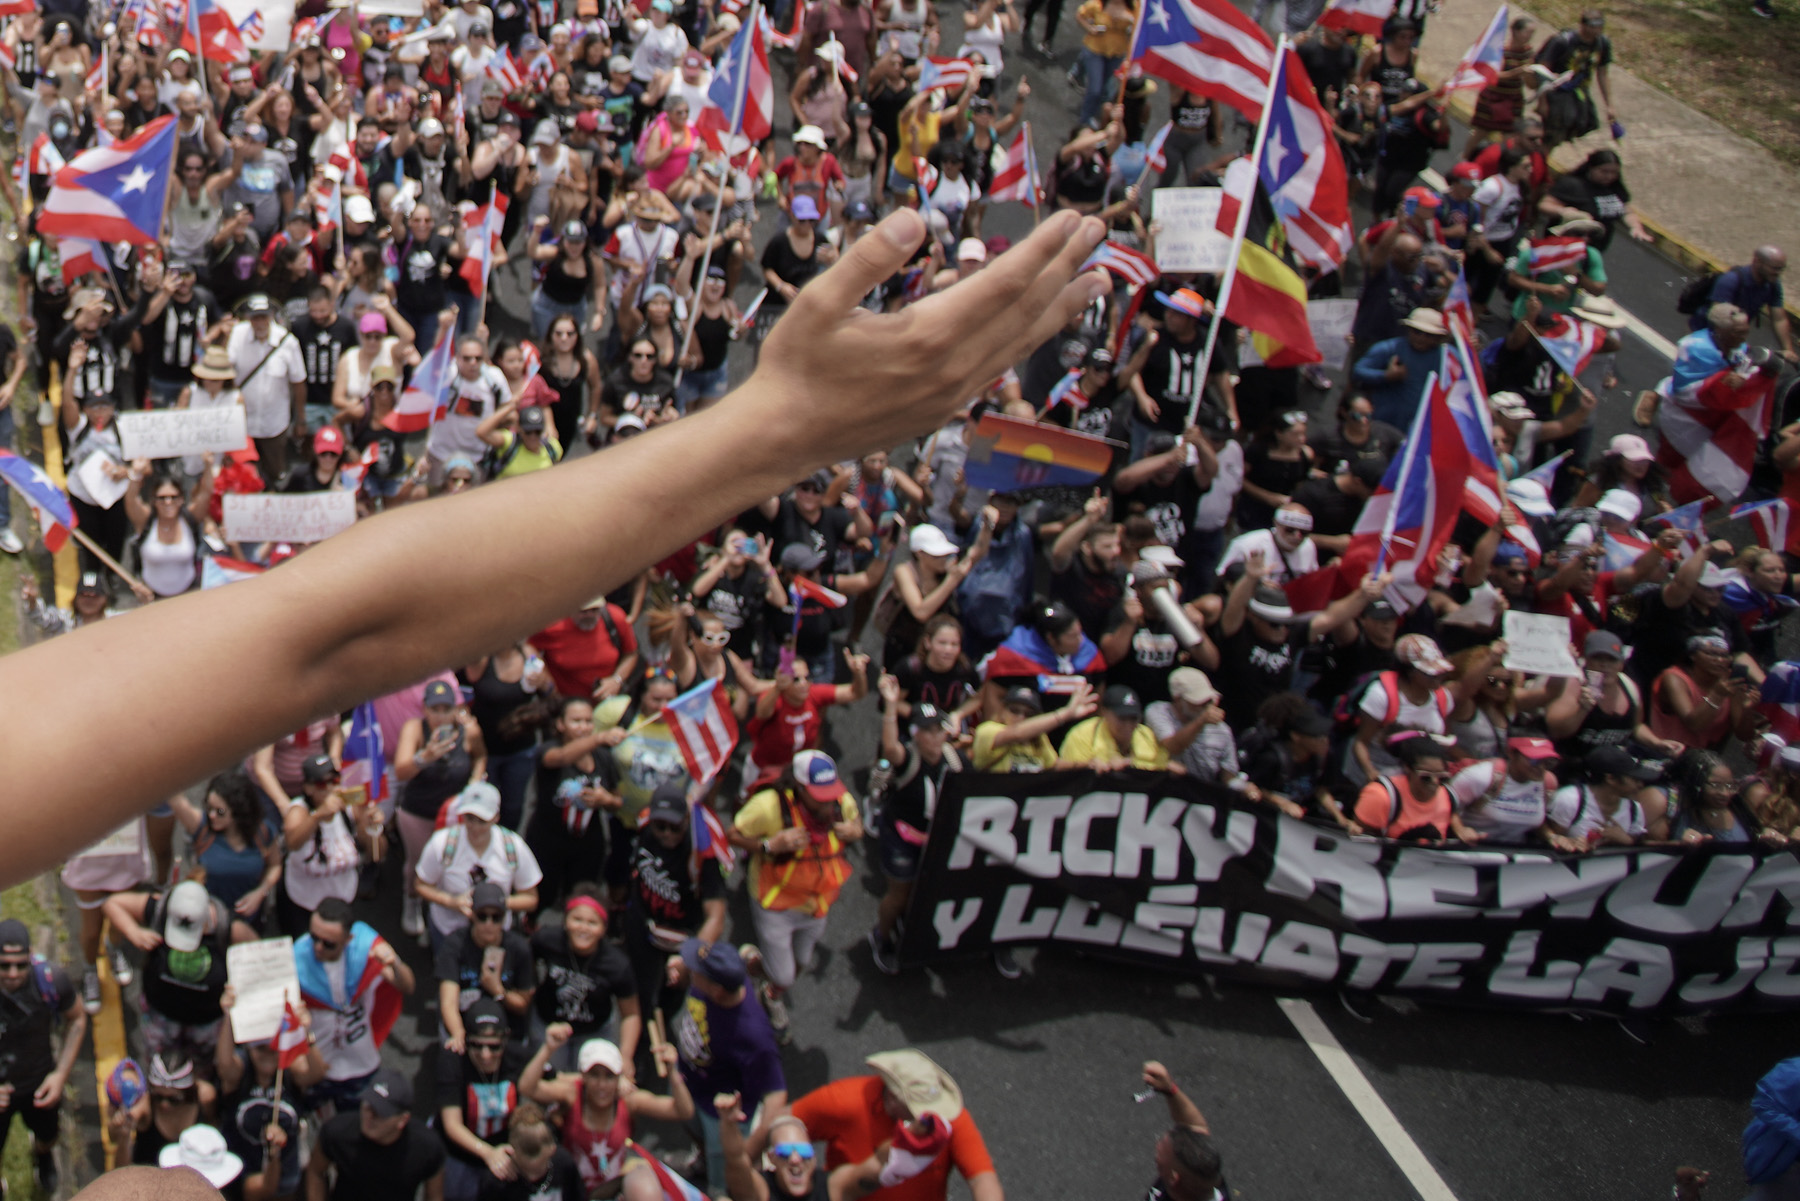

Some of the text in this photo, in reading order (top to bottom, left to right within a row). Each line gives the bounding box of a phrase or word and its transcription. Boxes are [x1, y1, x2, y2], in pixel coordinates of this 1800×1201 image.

[947, 792, 1257, 882] RICKY
[933, 897, 983, 950] Y
[1488, 930, 1674, 1009] LA
